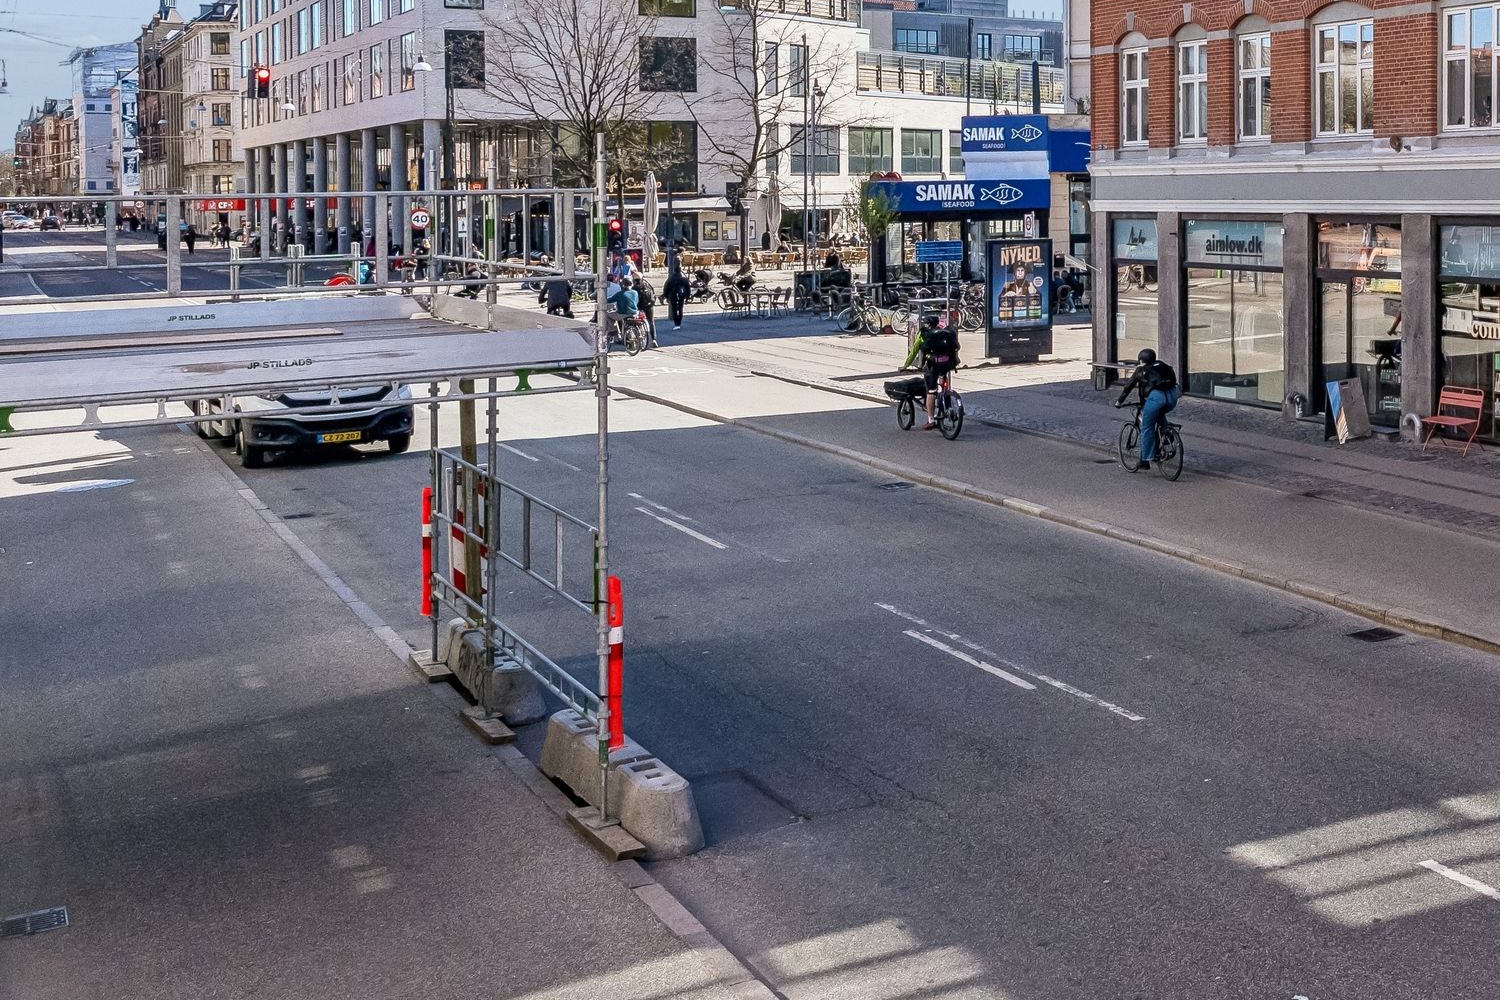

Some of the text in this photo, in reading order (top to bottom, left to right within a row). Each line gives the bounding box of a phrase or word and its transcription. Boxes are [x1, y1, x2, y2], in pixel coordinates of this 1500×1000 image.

[963, 127, 1005, 141] SAMAK
[916, 184, 975, 201] SAMAK
[412, 215, 428, 223] 40
[1205, 234, 1263, 254] aimlow.dk
[1001, 246, 1041, 266] NYHED
[178, 313, 216, 321] STILLADS
[247, 358, 313, 370] JP STILLADS
[323, 433, 334, 442] CZ
[334, 433, 345, 441] 72
